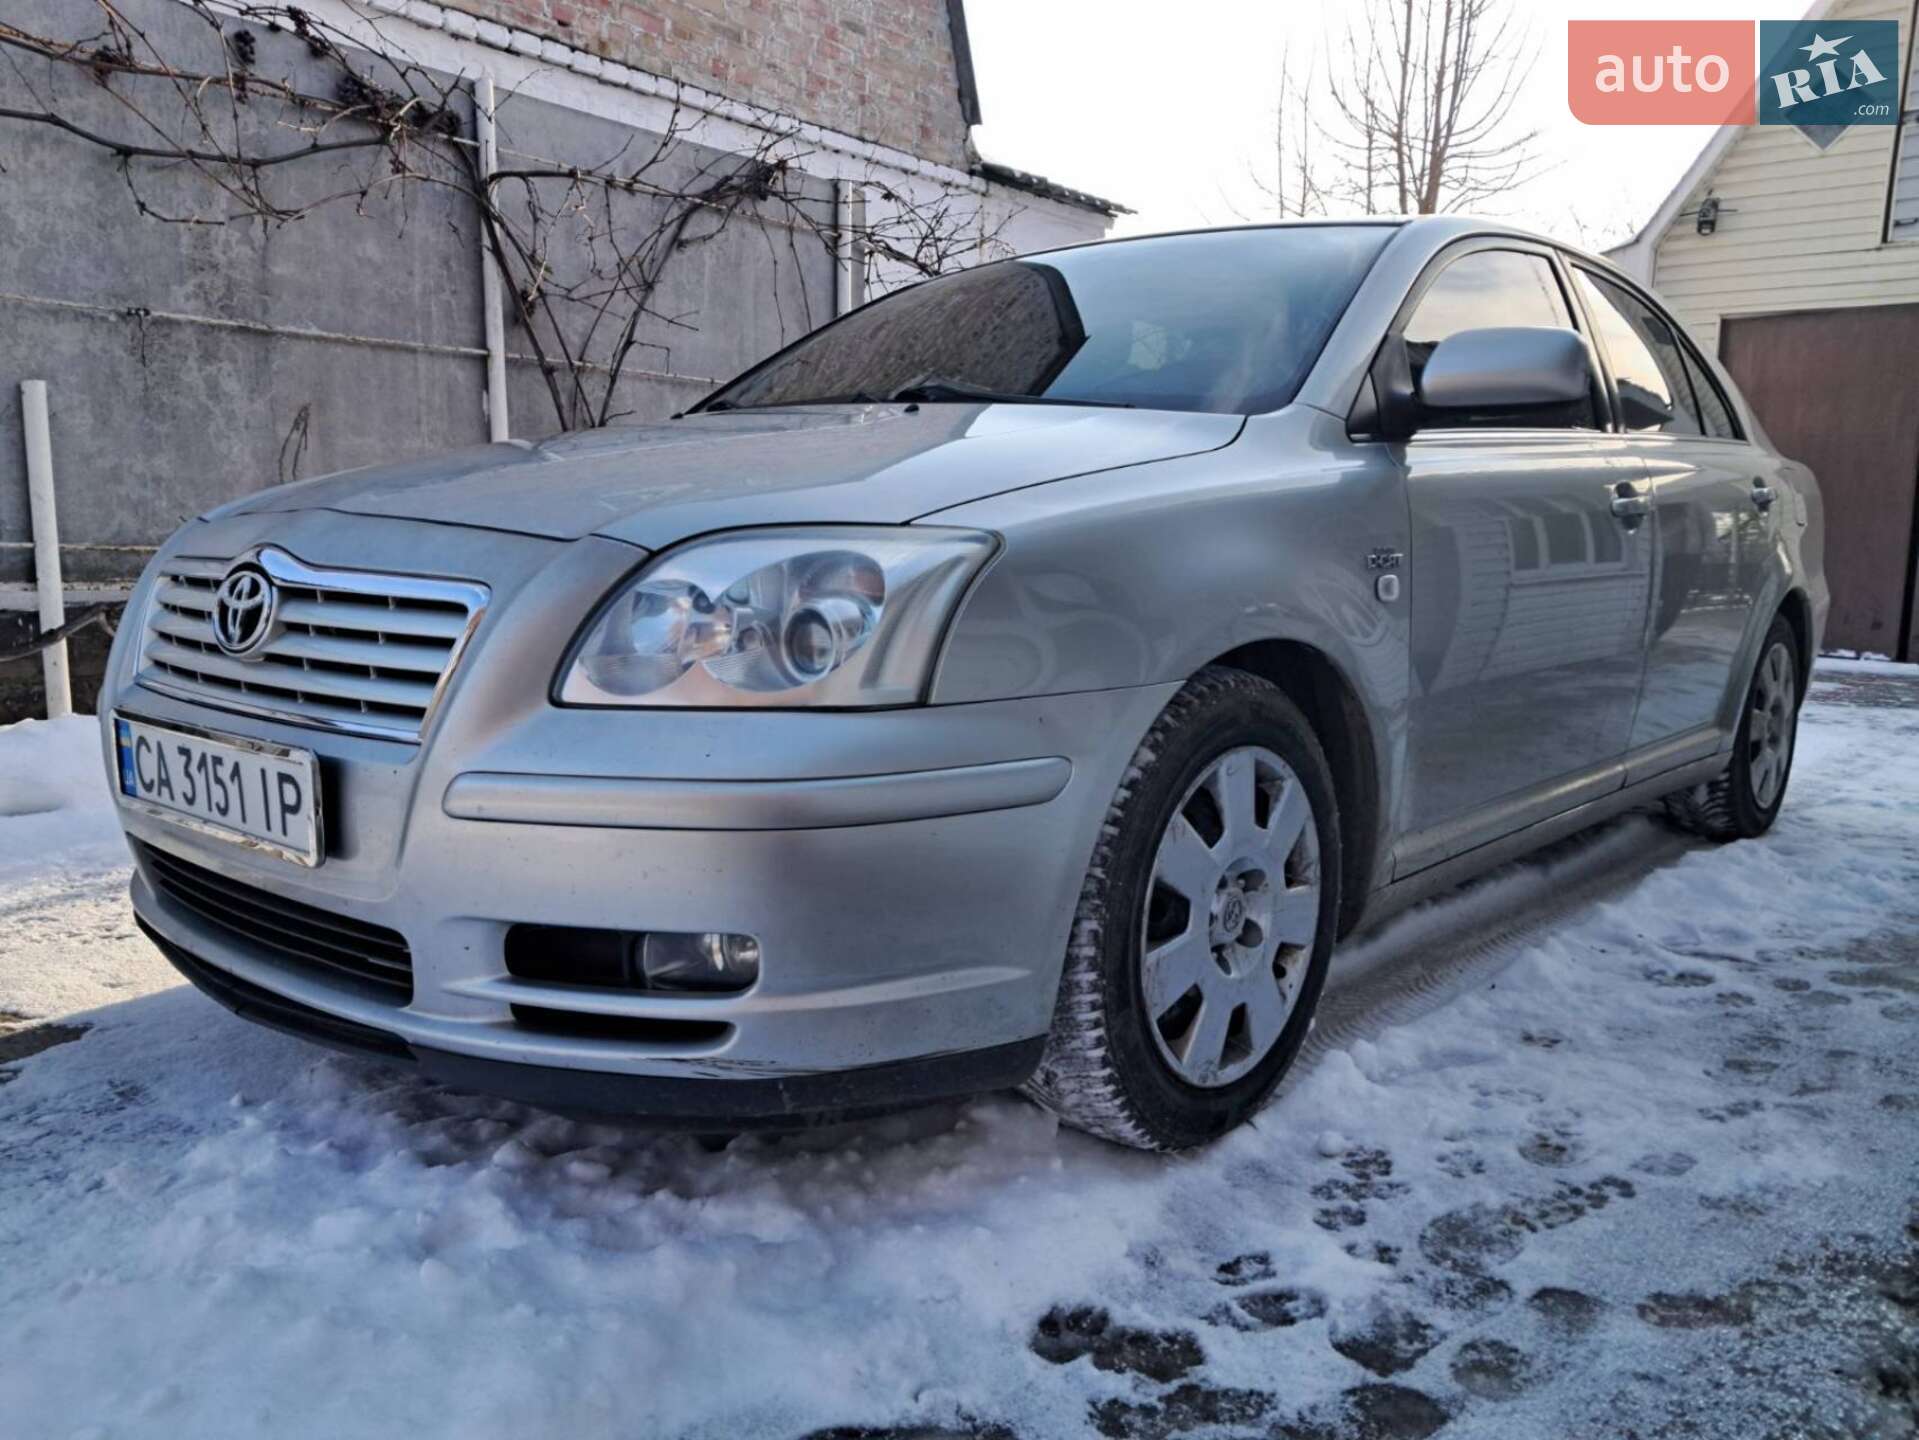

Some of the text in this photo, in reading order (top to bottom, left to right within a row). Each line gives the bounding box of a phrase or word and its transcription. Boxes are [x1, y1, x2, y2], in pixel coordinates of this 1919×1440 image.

[135, 735, 301, 836] CA 3151 IP
